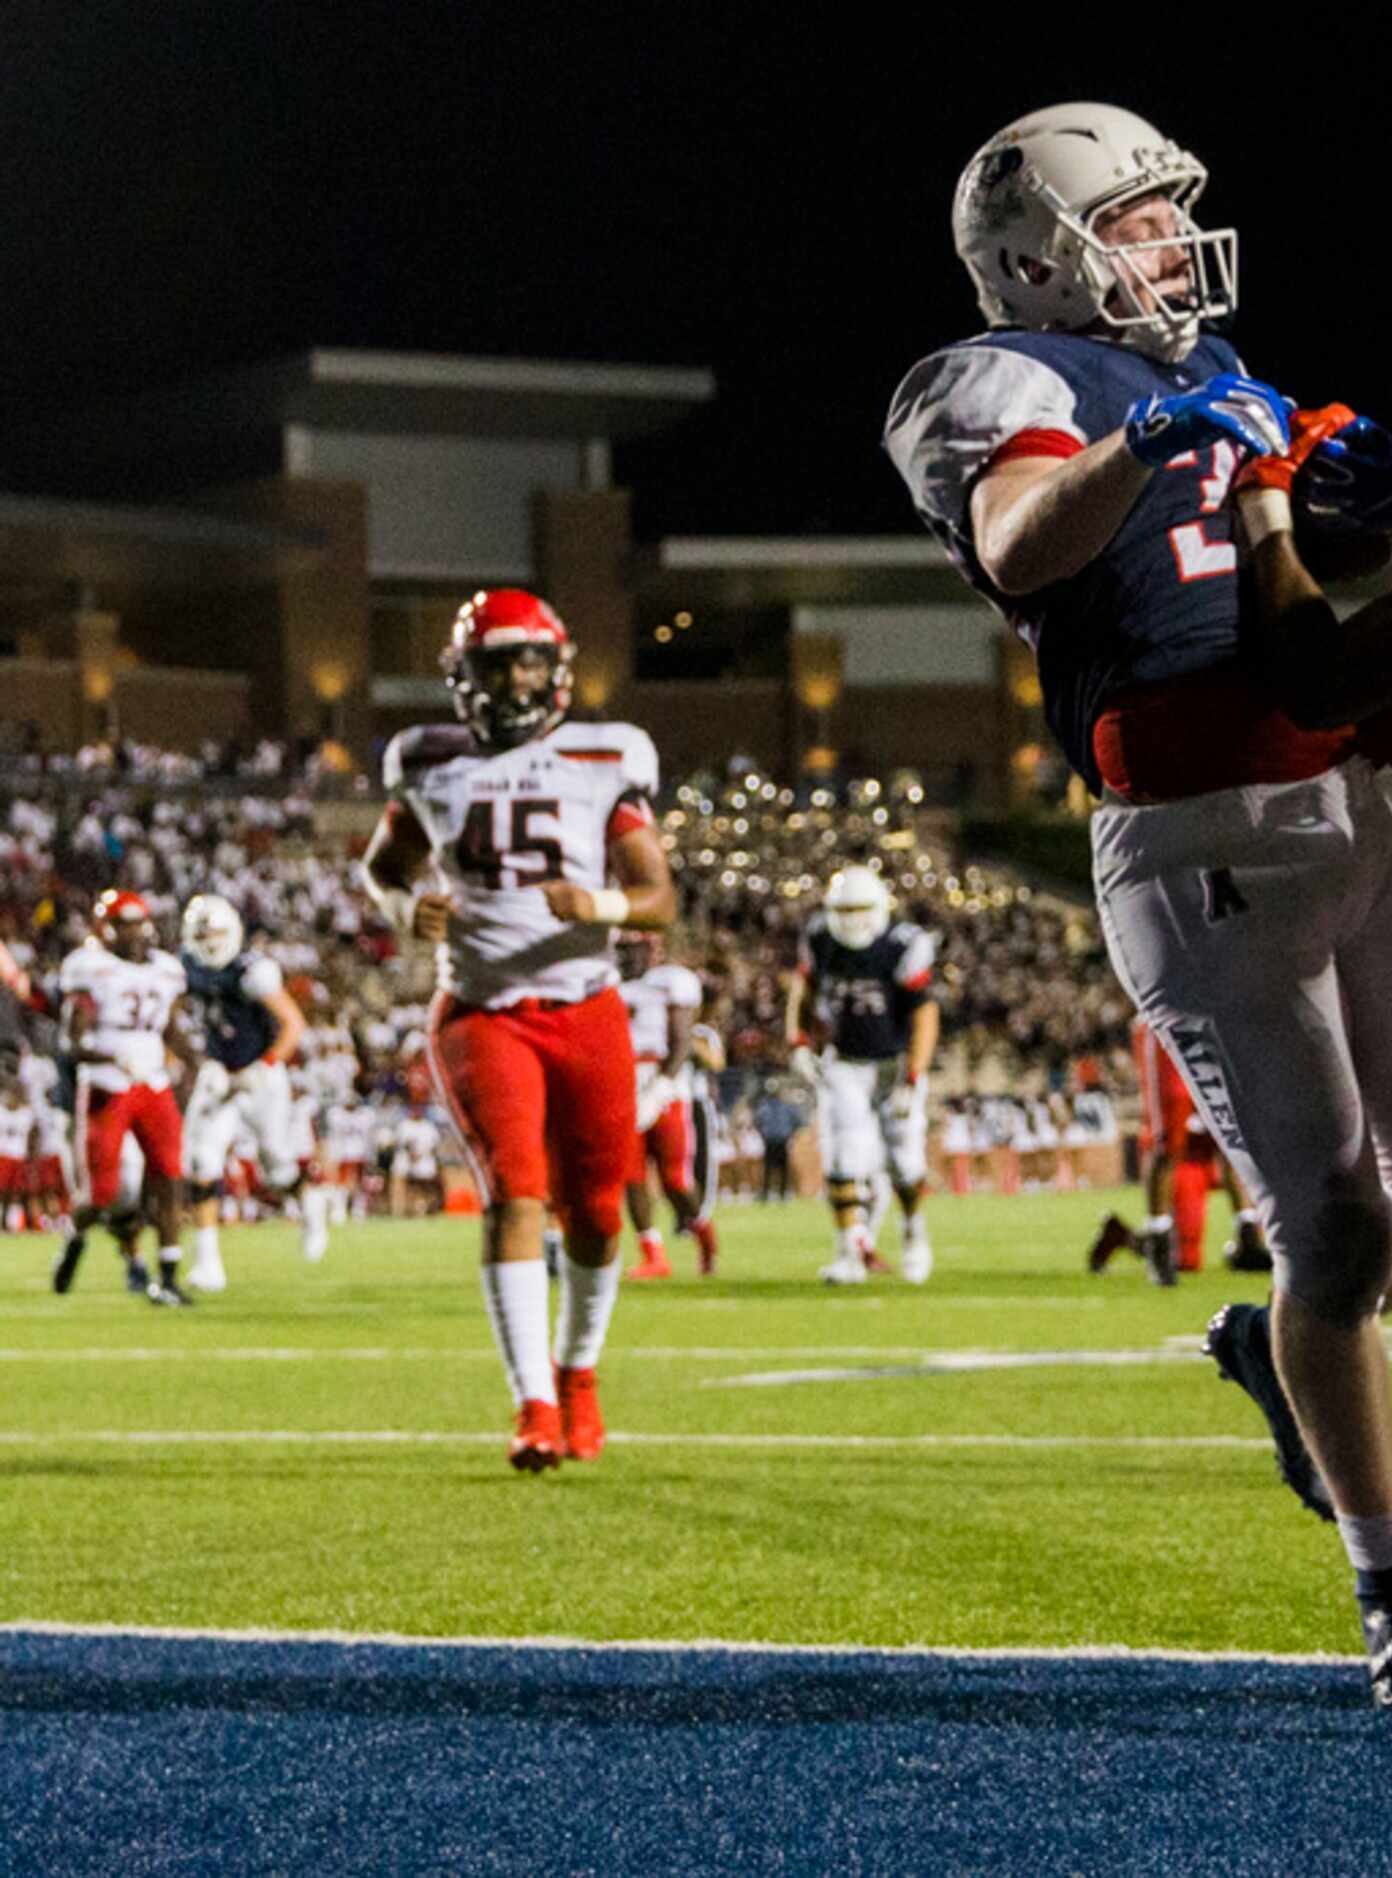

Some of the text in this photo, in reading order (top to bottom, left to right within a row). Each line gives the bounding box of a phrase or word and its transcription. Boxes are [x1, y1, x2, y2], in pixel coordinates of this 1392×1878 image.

[455, 799, 563, 891] 45
[1201, 868, 1249, 920] A
[1168, 1021, 1248, 1151] ALLEN
